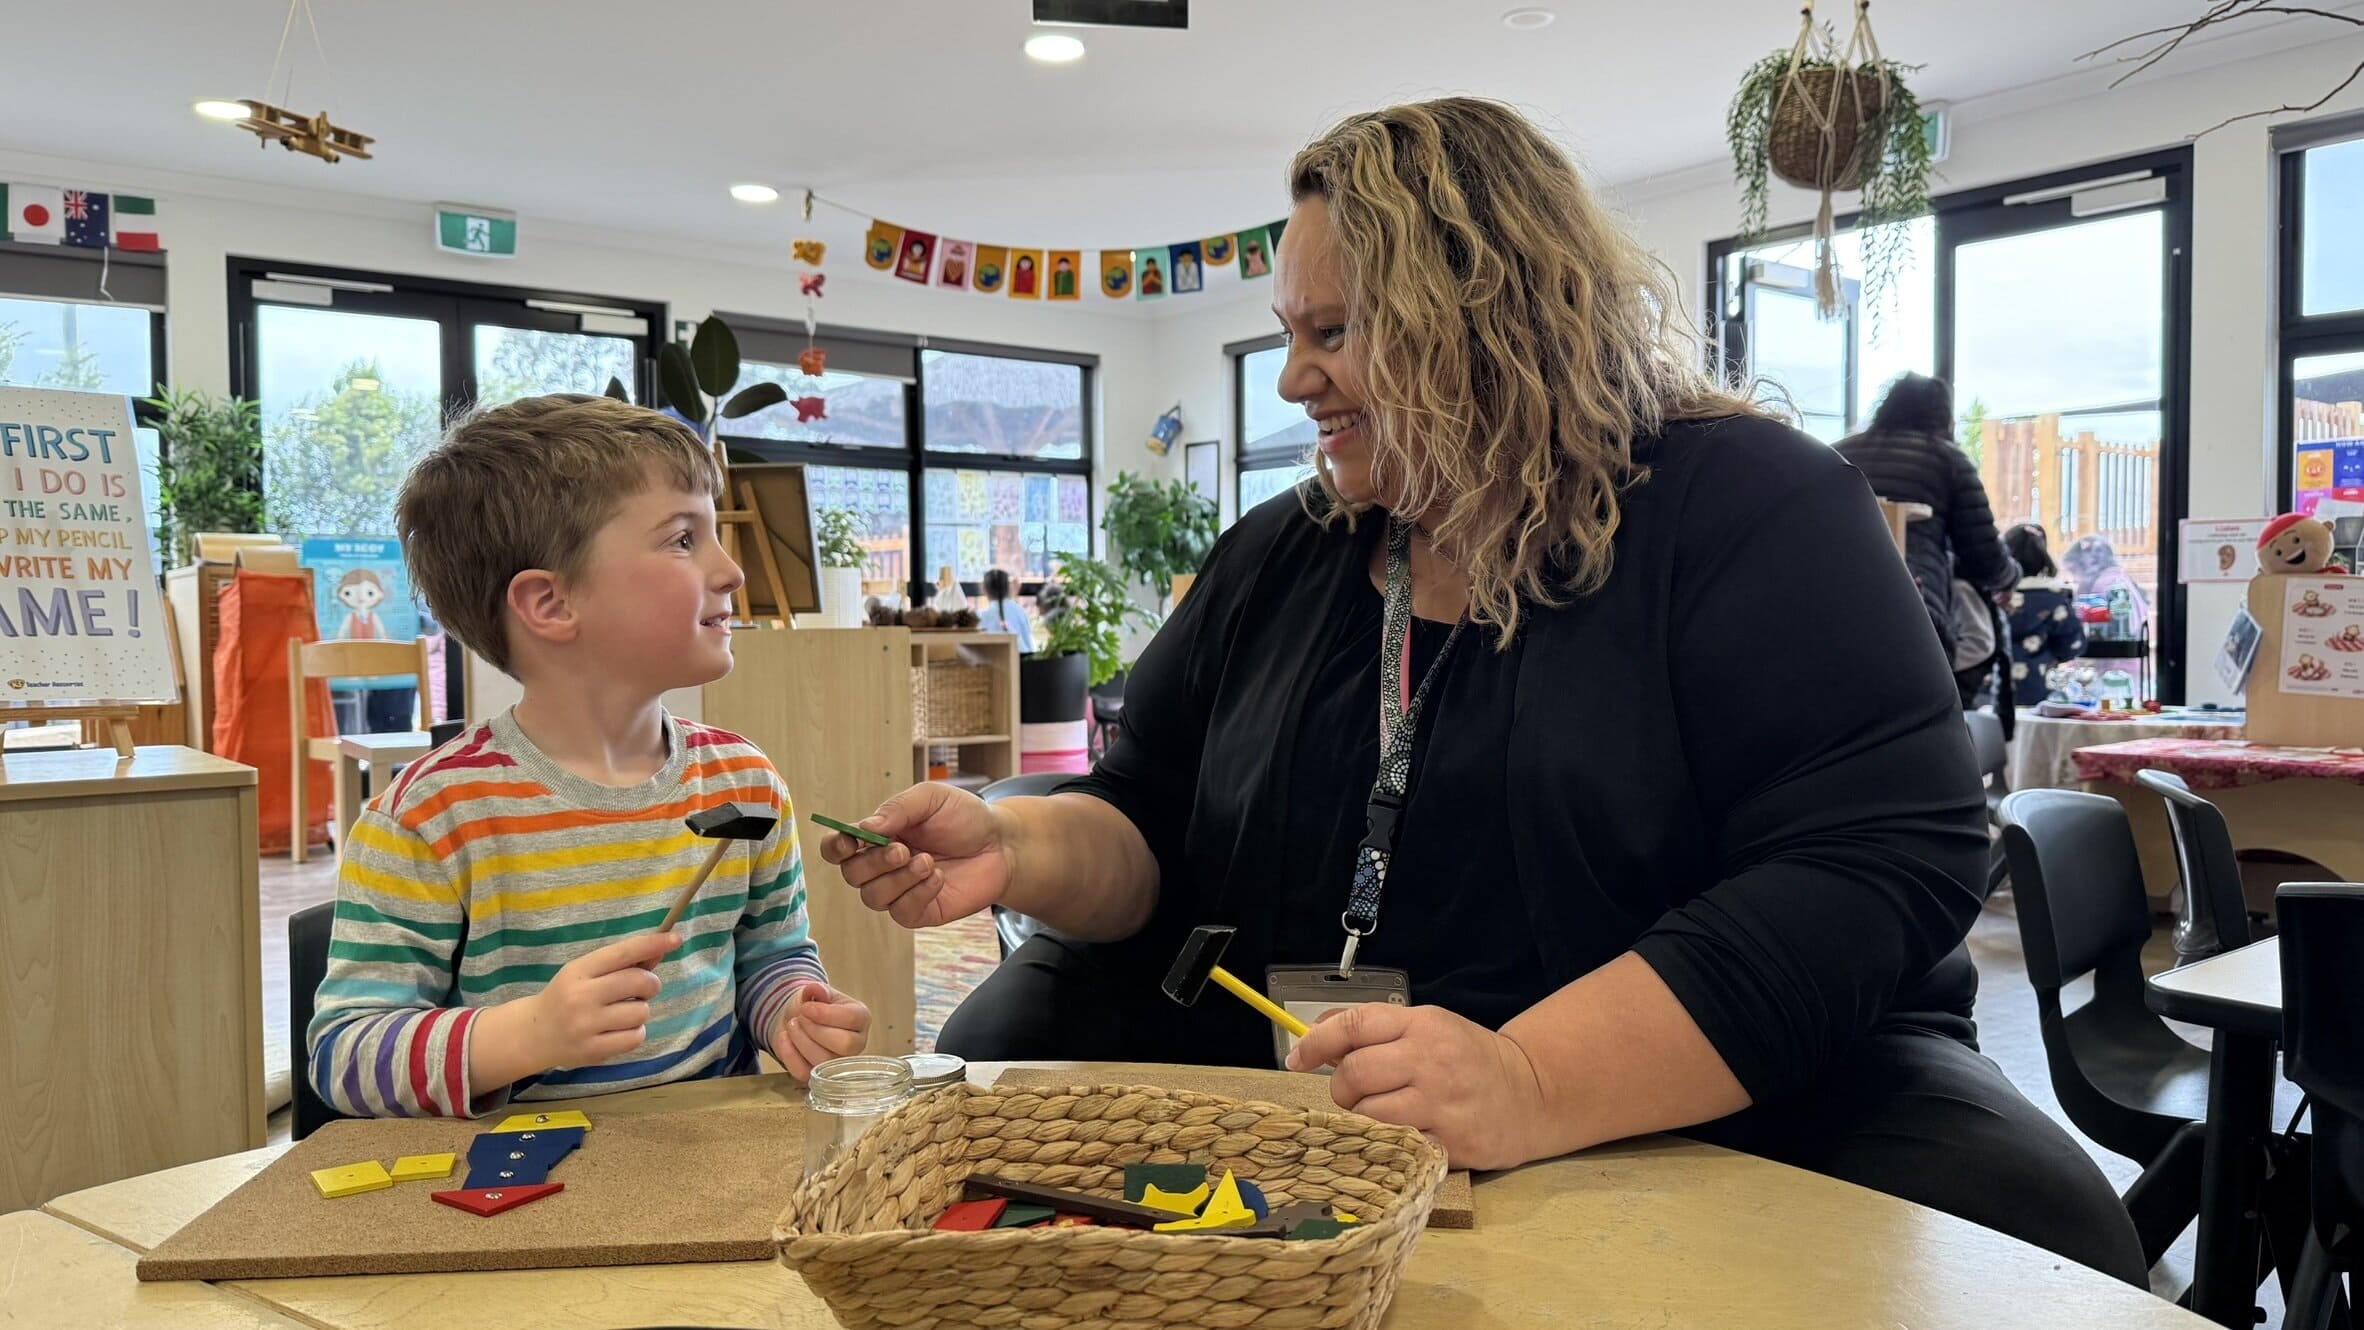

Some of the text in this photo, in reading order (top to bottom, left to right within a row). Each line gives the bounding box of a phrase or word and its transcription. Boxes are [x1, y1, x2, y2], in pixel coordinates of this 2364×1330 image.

[0, 422, 117, 464] FIRST
[14, 466, 126, 498] I DO IS
[3, 499, 46, 519] THE
[15, 527, 51, 548] MY
[56, 528, 134, 550] PENCIL
[87, 556, 133, 581] MY
